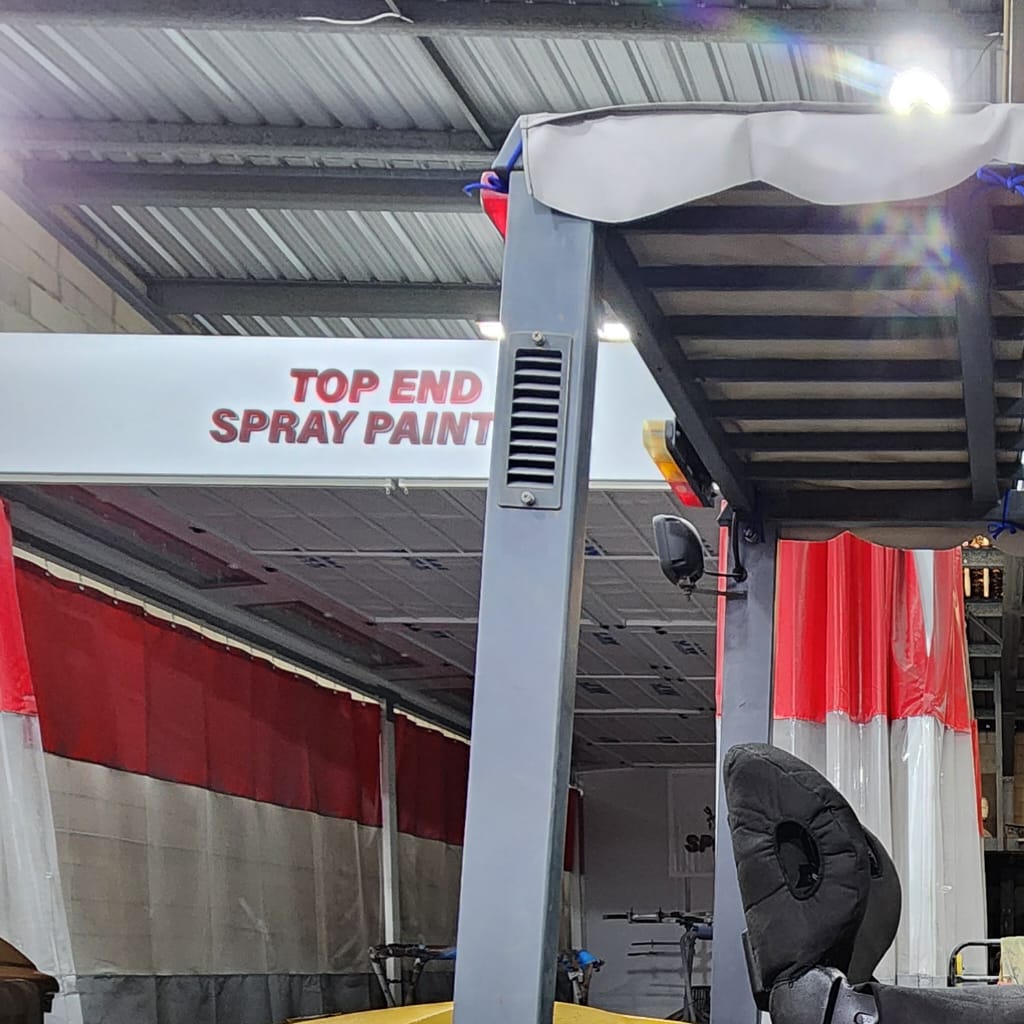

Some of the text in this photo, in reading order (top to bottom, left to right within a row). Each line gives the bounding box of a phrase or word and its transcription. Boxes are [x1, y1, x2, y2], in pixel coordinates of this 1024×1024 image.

[290, 368, 483, 404] TOP END
[209, 408, 359, 444] SPRAY
